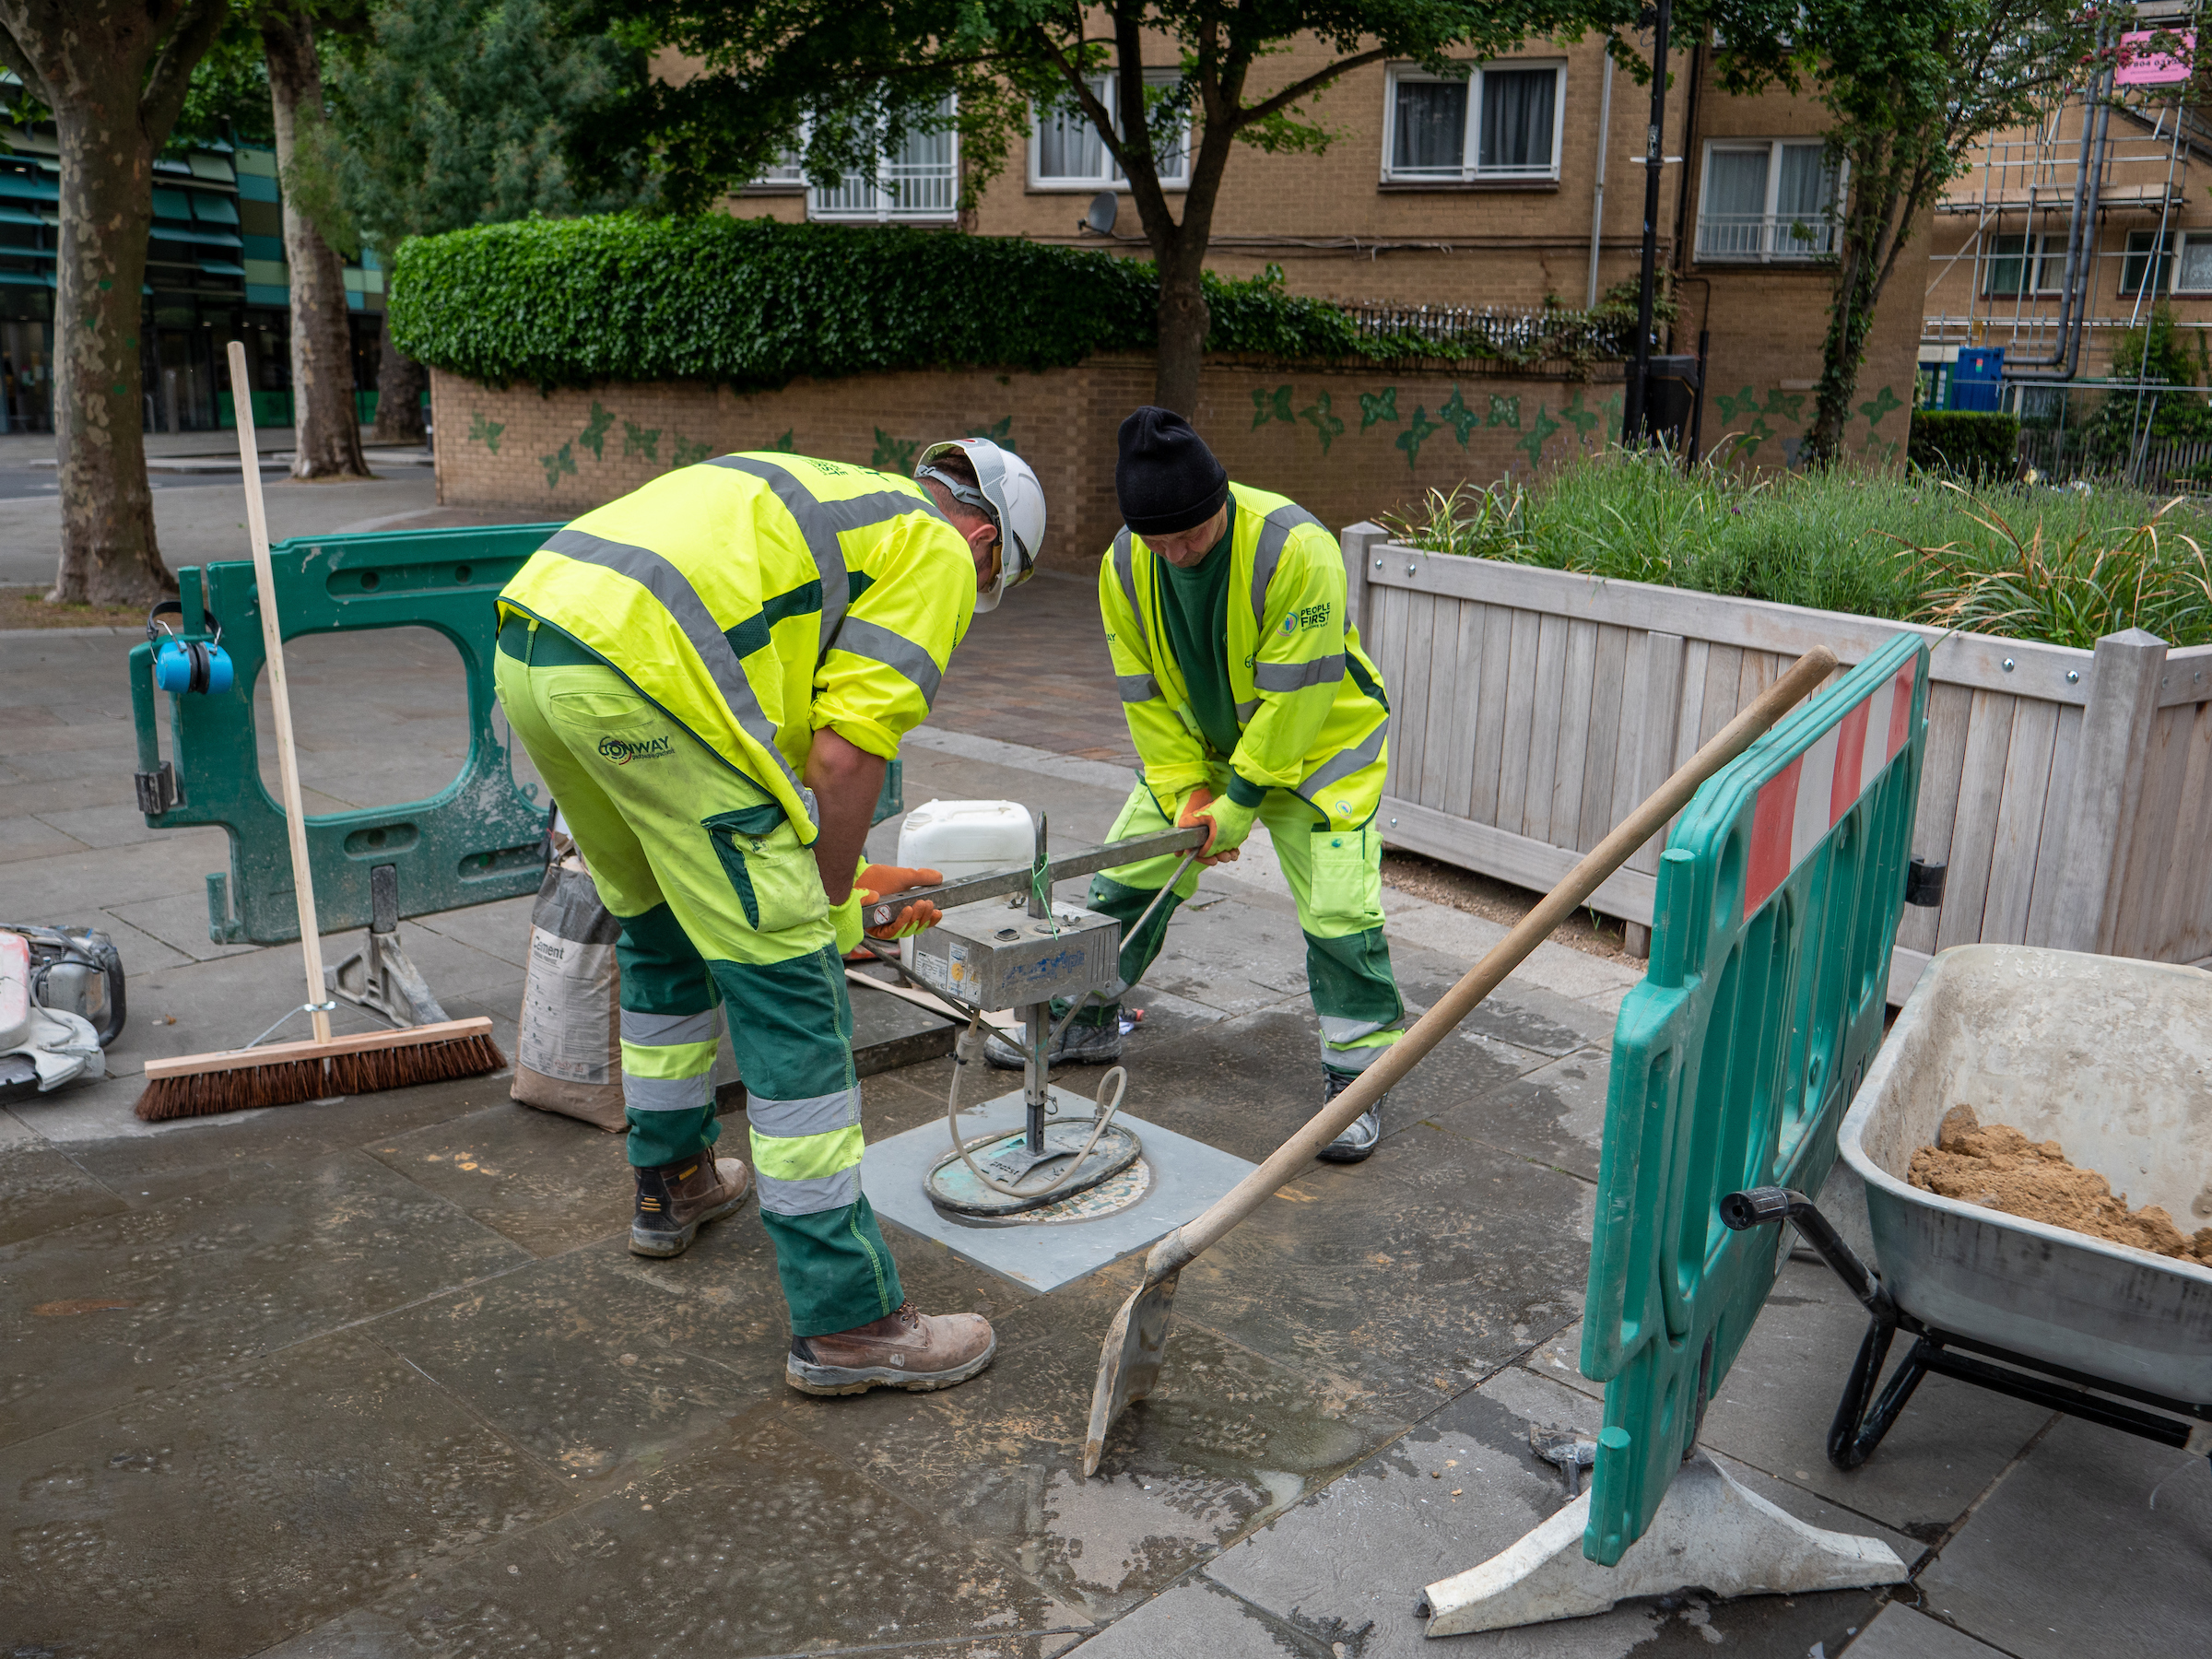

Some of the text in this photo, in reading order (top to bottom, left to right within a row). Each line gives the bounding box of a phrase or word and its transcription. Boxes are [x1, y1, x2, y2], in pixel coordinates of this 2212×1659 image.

[1300, 602, 1330, 616] PEOPLE
[1300, 611, 1330, 627] FIRST
[598, 735, 669, 756] CONWAY
[534, 935, 564, 959] Cement
